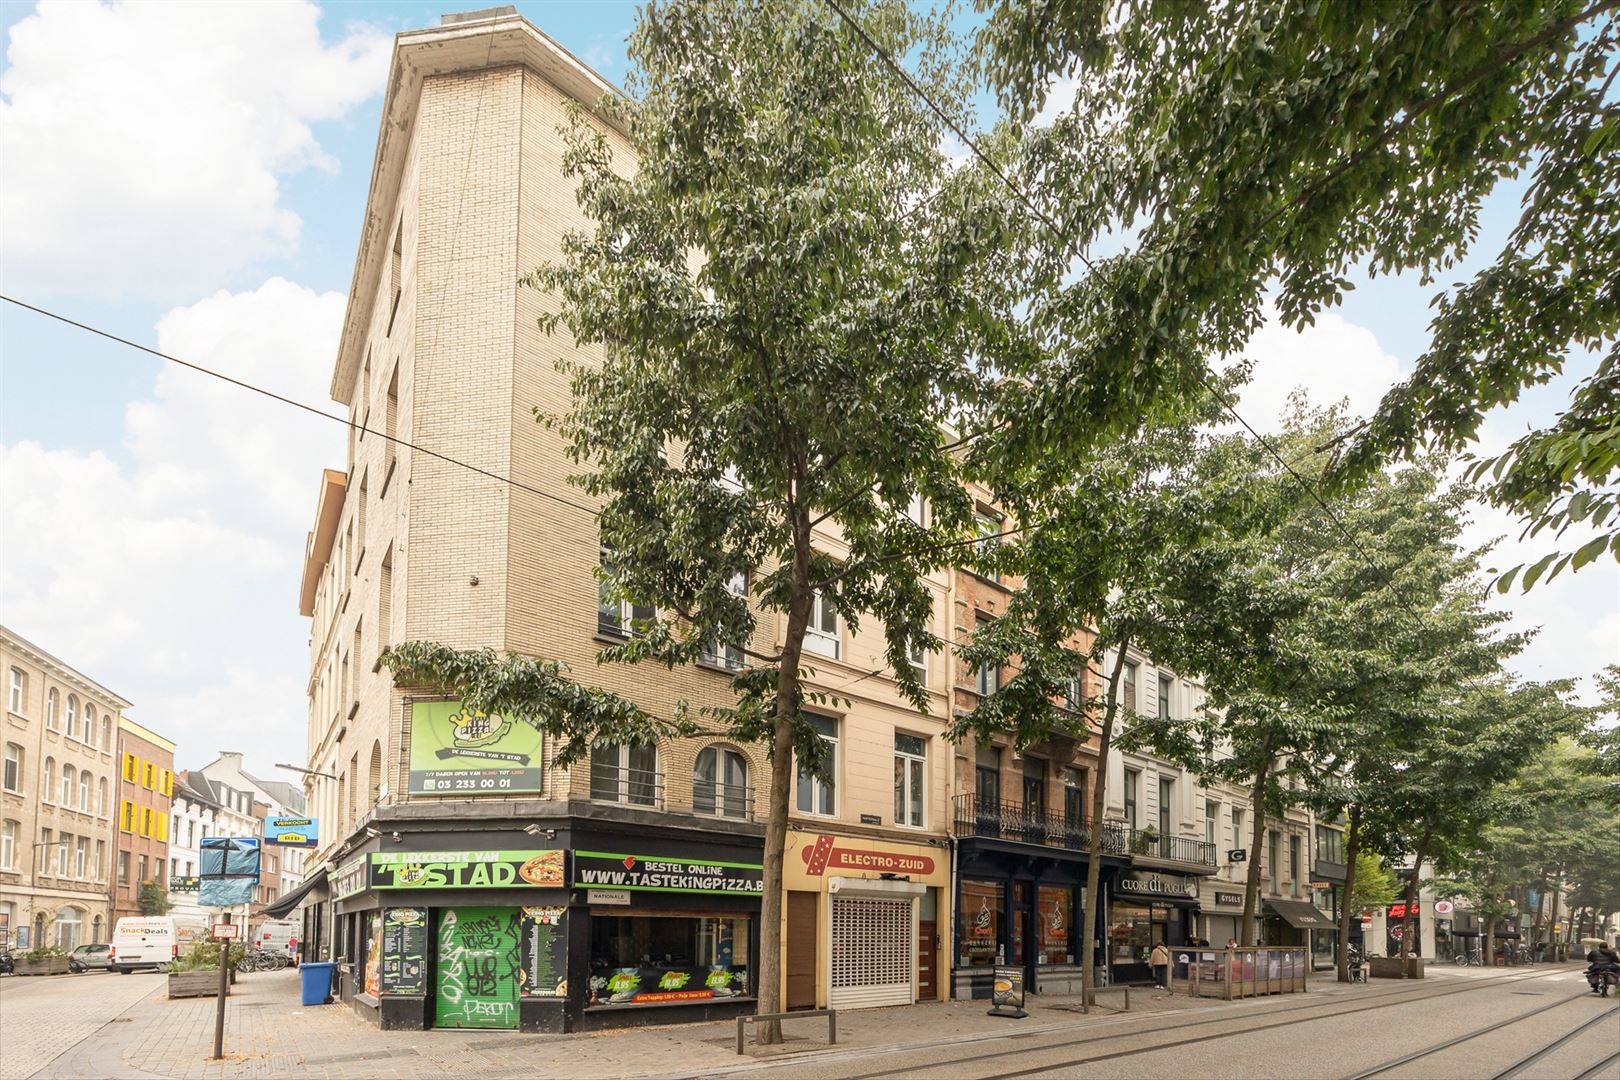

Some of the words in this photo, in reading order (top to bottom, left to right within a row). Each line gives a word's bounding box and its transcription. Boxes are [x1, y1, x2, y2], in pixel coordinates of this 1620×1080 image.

[461, 726, 489, 734] PIZZA
[437, 780, 451, 789] 03
[456, 779, 476, 789] 233
[480, 779, 494, 788] 00
[499, 779, 511, 788] 01
[474, 851, 499, 862] VAN
[840, 853, 924, 870] ELECTRO-ZUID
[644, 862, 684, 873] BESTEL
[424, 862, 516, 887] STAD
[1122, 879, 1148, 892] CUORE
[1150, 874, 1161, 892] di
[1221, 895, 1240, 903] GYSELS
[120, 927, 168, 935] SnackDeals
